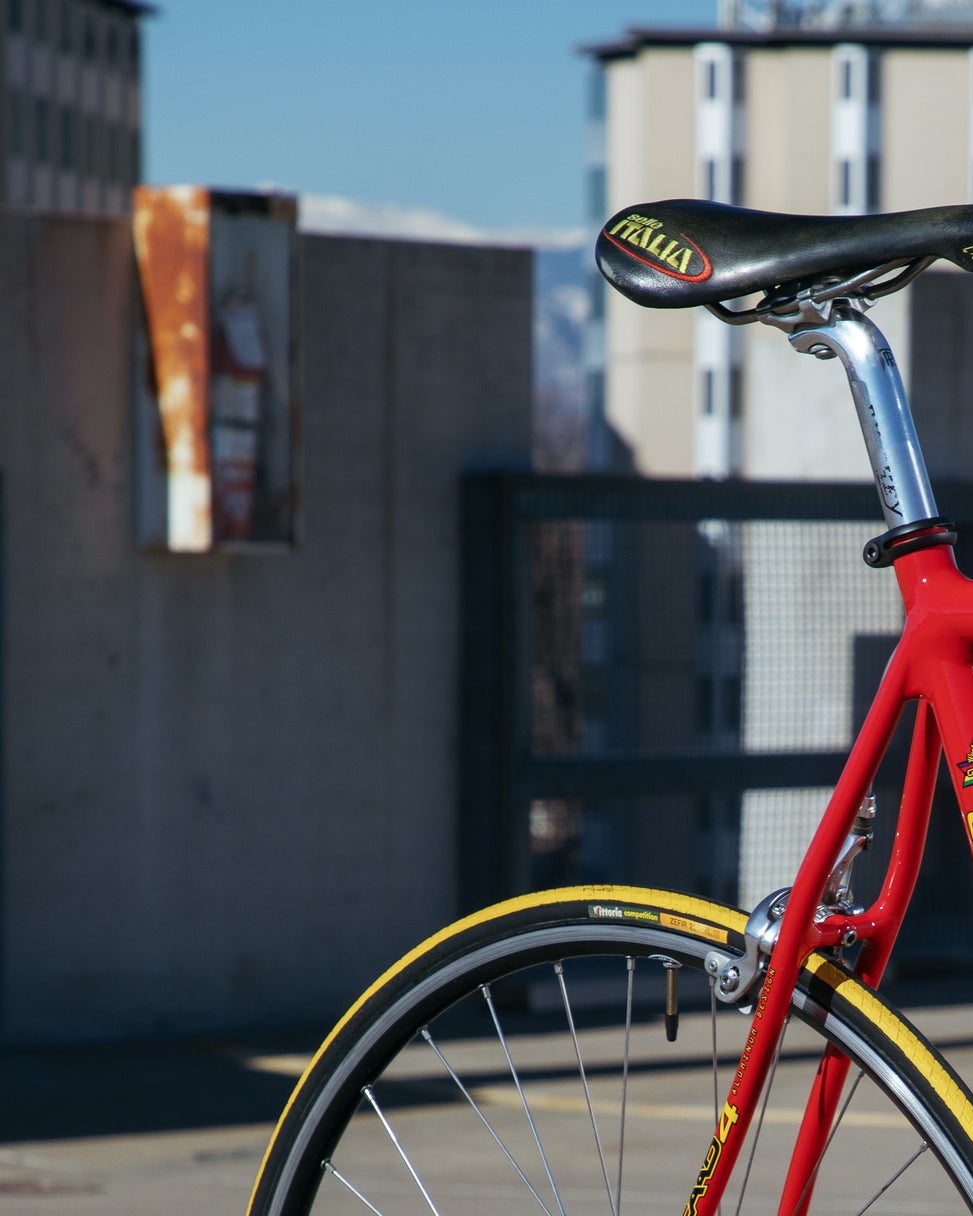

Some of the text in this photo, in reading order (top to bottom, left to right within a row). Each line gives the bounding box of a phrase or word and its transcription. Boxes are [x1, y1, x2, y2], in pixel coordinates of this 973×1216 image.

[627, 213, 664, 230] selle
[609, 219, 693, 274] ITALIA
[593, 905, 659, 921] Vittoria competition
[731, 1026, 757, 1096] ALUMINUM
[756, 966, 775, 1020] DESIGN
